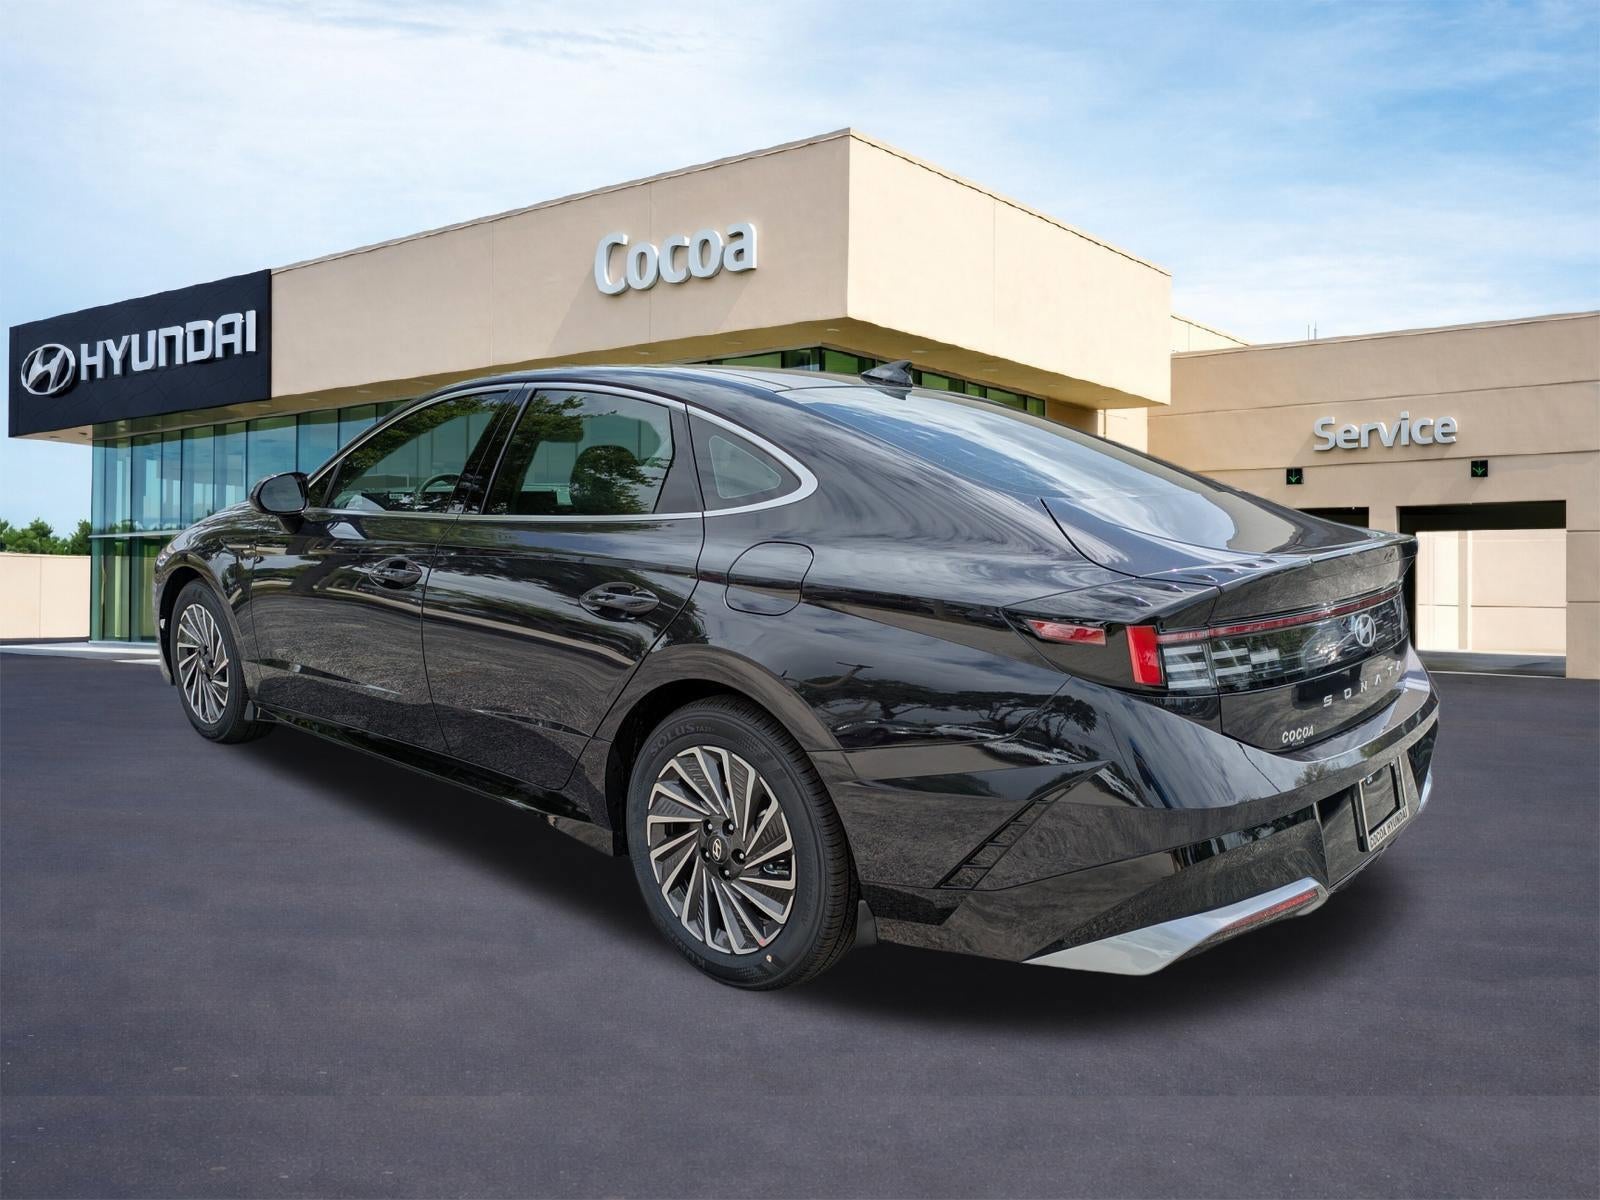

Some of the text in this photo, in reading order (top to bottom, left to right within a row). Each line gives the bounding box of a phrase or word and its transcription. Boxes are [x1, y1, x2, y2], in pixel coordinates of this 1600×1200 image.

[594, 222, 757, 295] Cocoa
[80, 310, 256, 381] HYUNDAI
[1313, 411, 1458, 451] Service
[1281, 725, 1314, 744] COCOA
